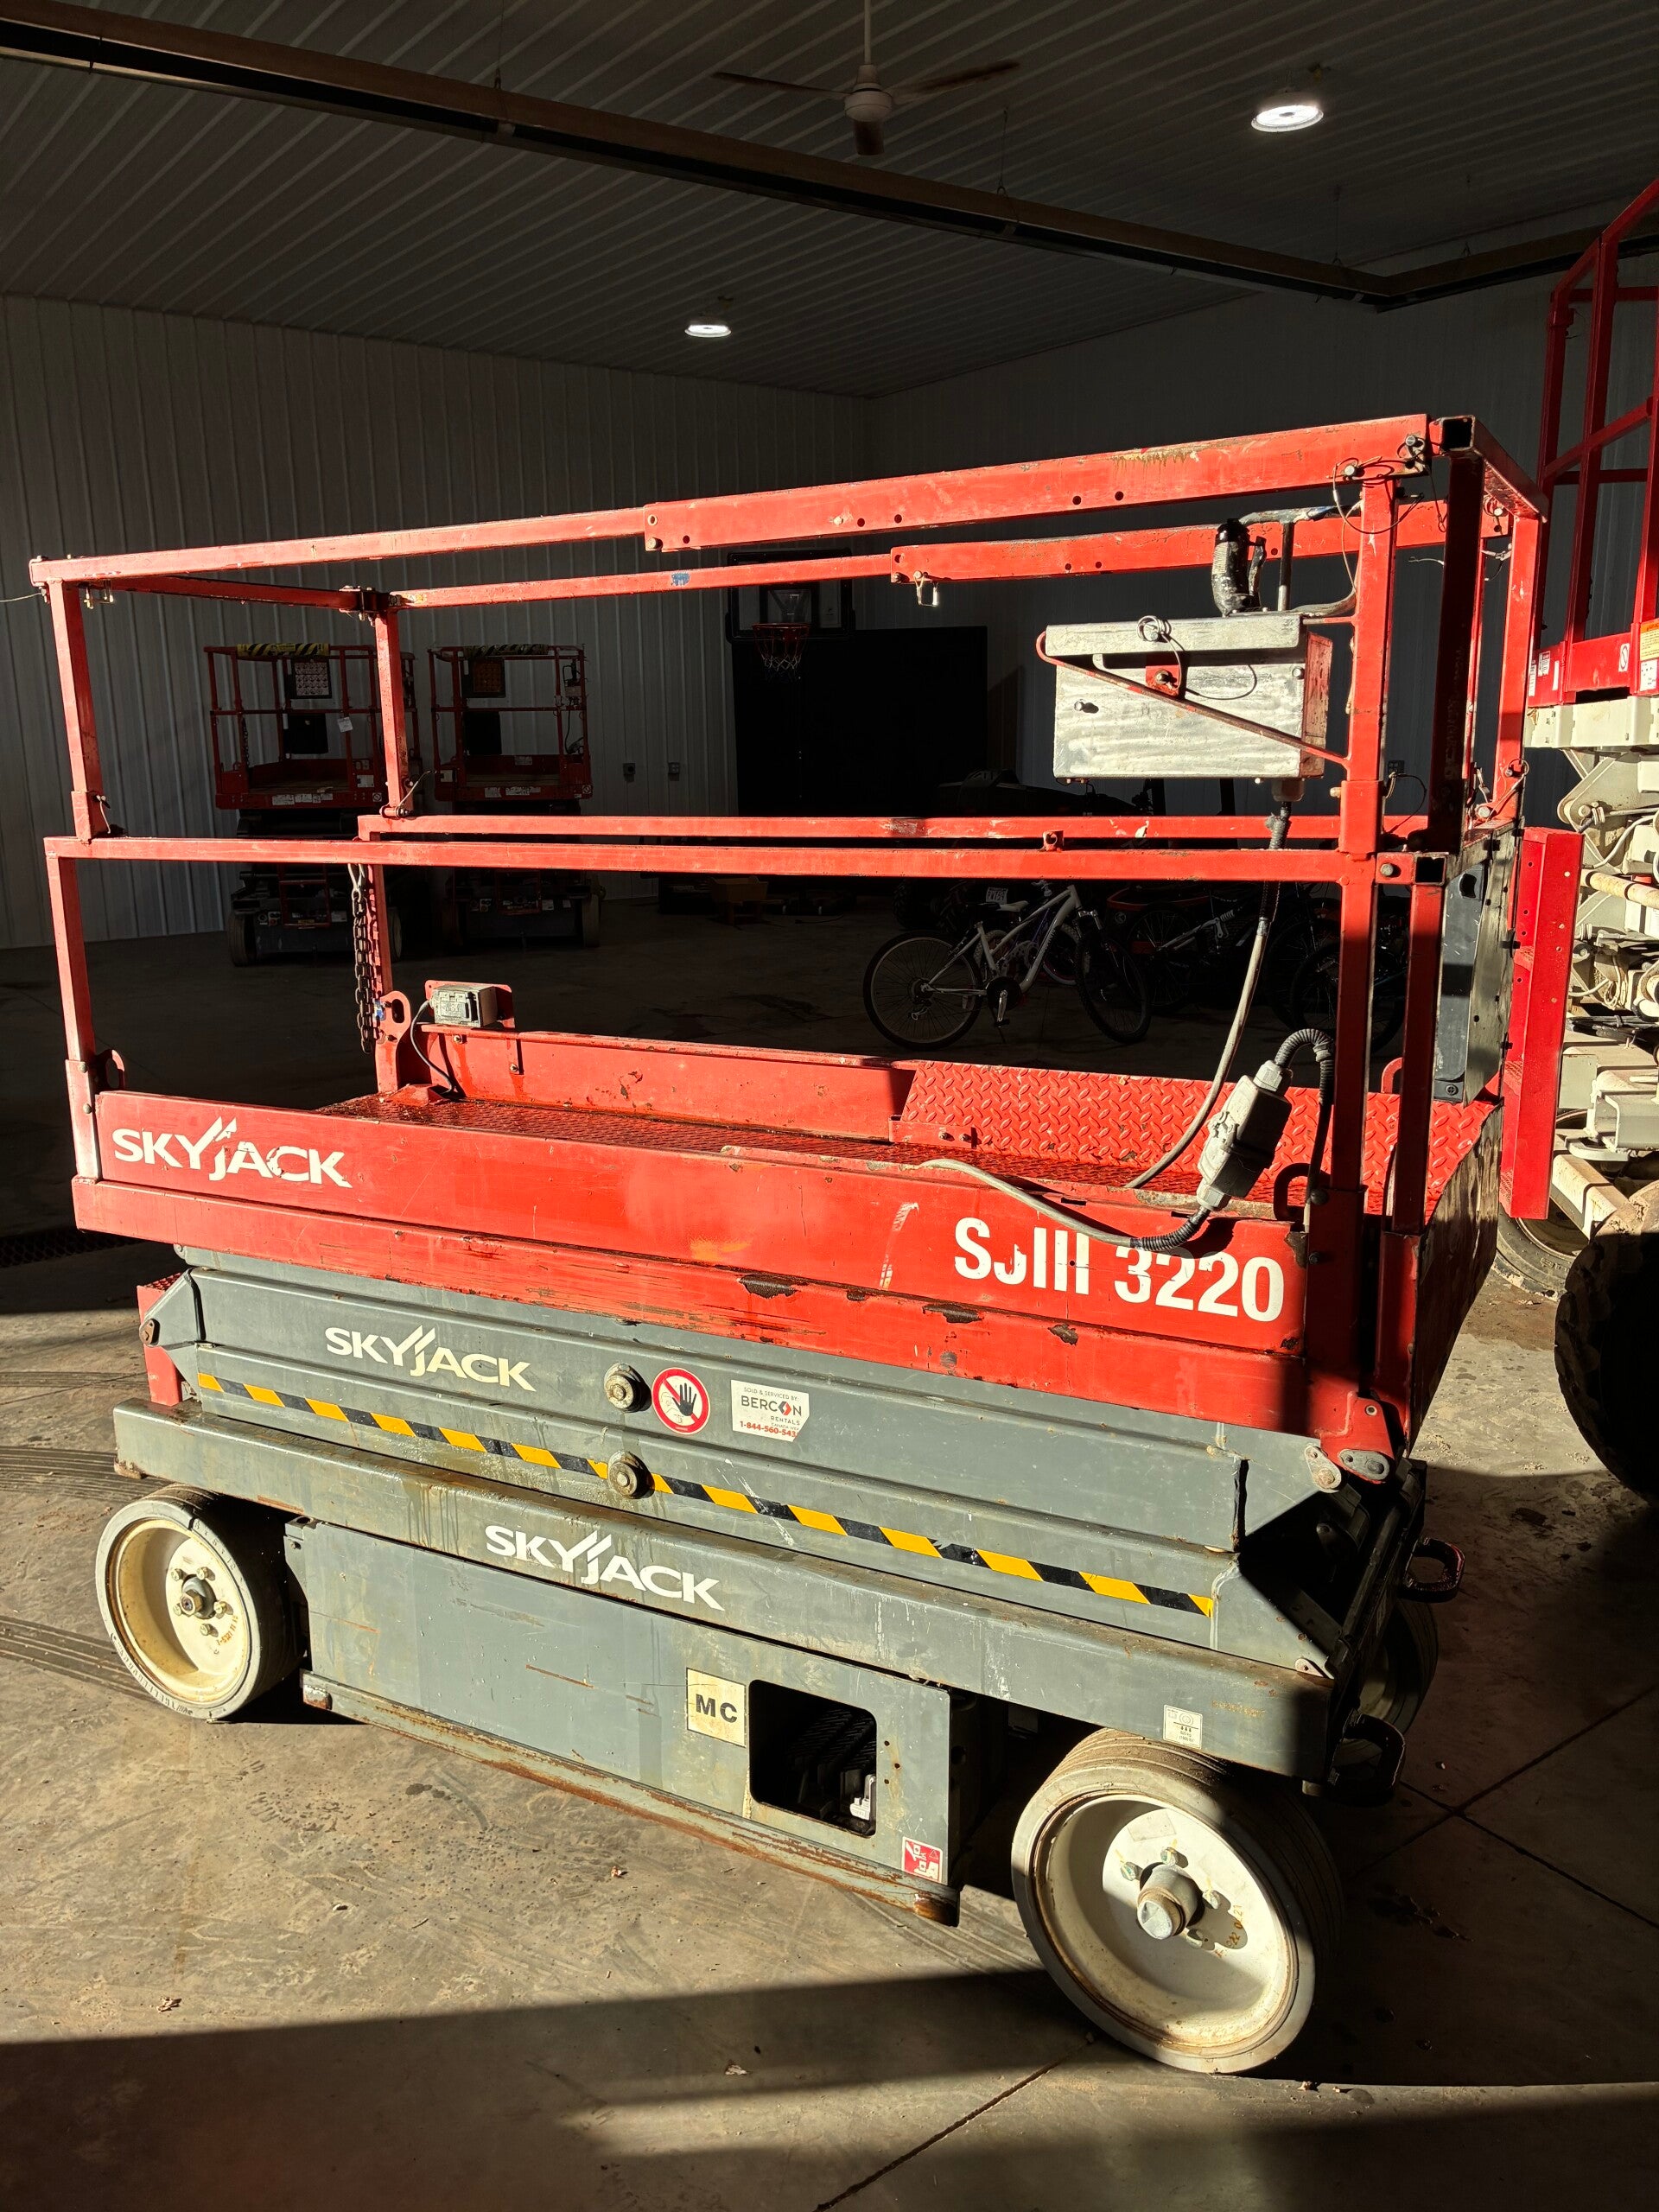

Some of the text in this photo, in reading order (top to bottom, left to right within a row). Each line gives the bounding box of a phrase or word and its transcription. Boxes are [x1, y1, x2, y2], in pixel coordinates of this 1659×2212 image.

[111, 1116, 353, 1189] SKYJACK
[1114, 1245, 1285, 1323] 3220
[324, 1324, 537, 1392] SKYJACK
[741, 1395, 802, 1416] BERCON
[765, 1390, 790, 1400] SERVICED
[770, 1415, 801, 1426] RENTALS
[485, 1524, 725, 1611] SKYJACK
[696, 1693, 738, 1724] MC
